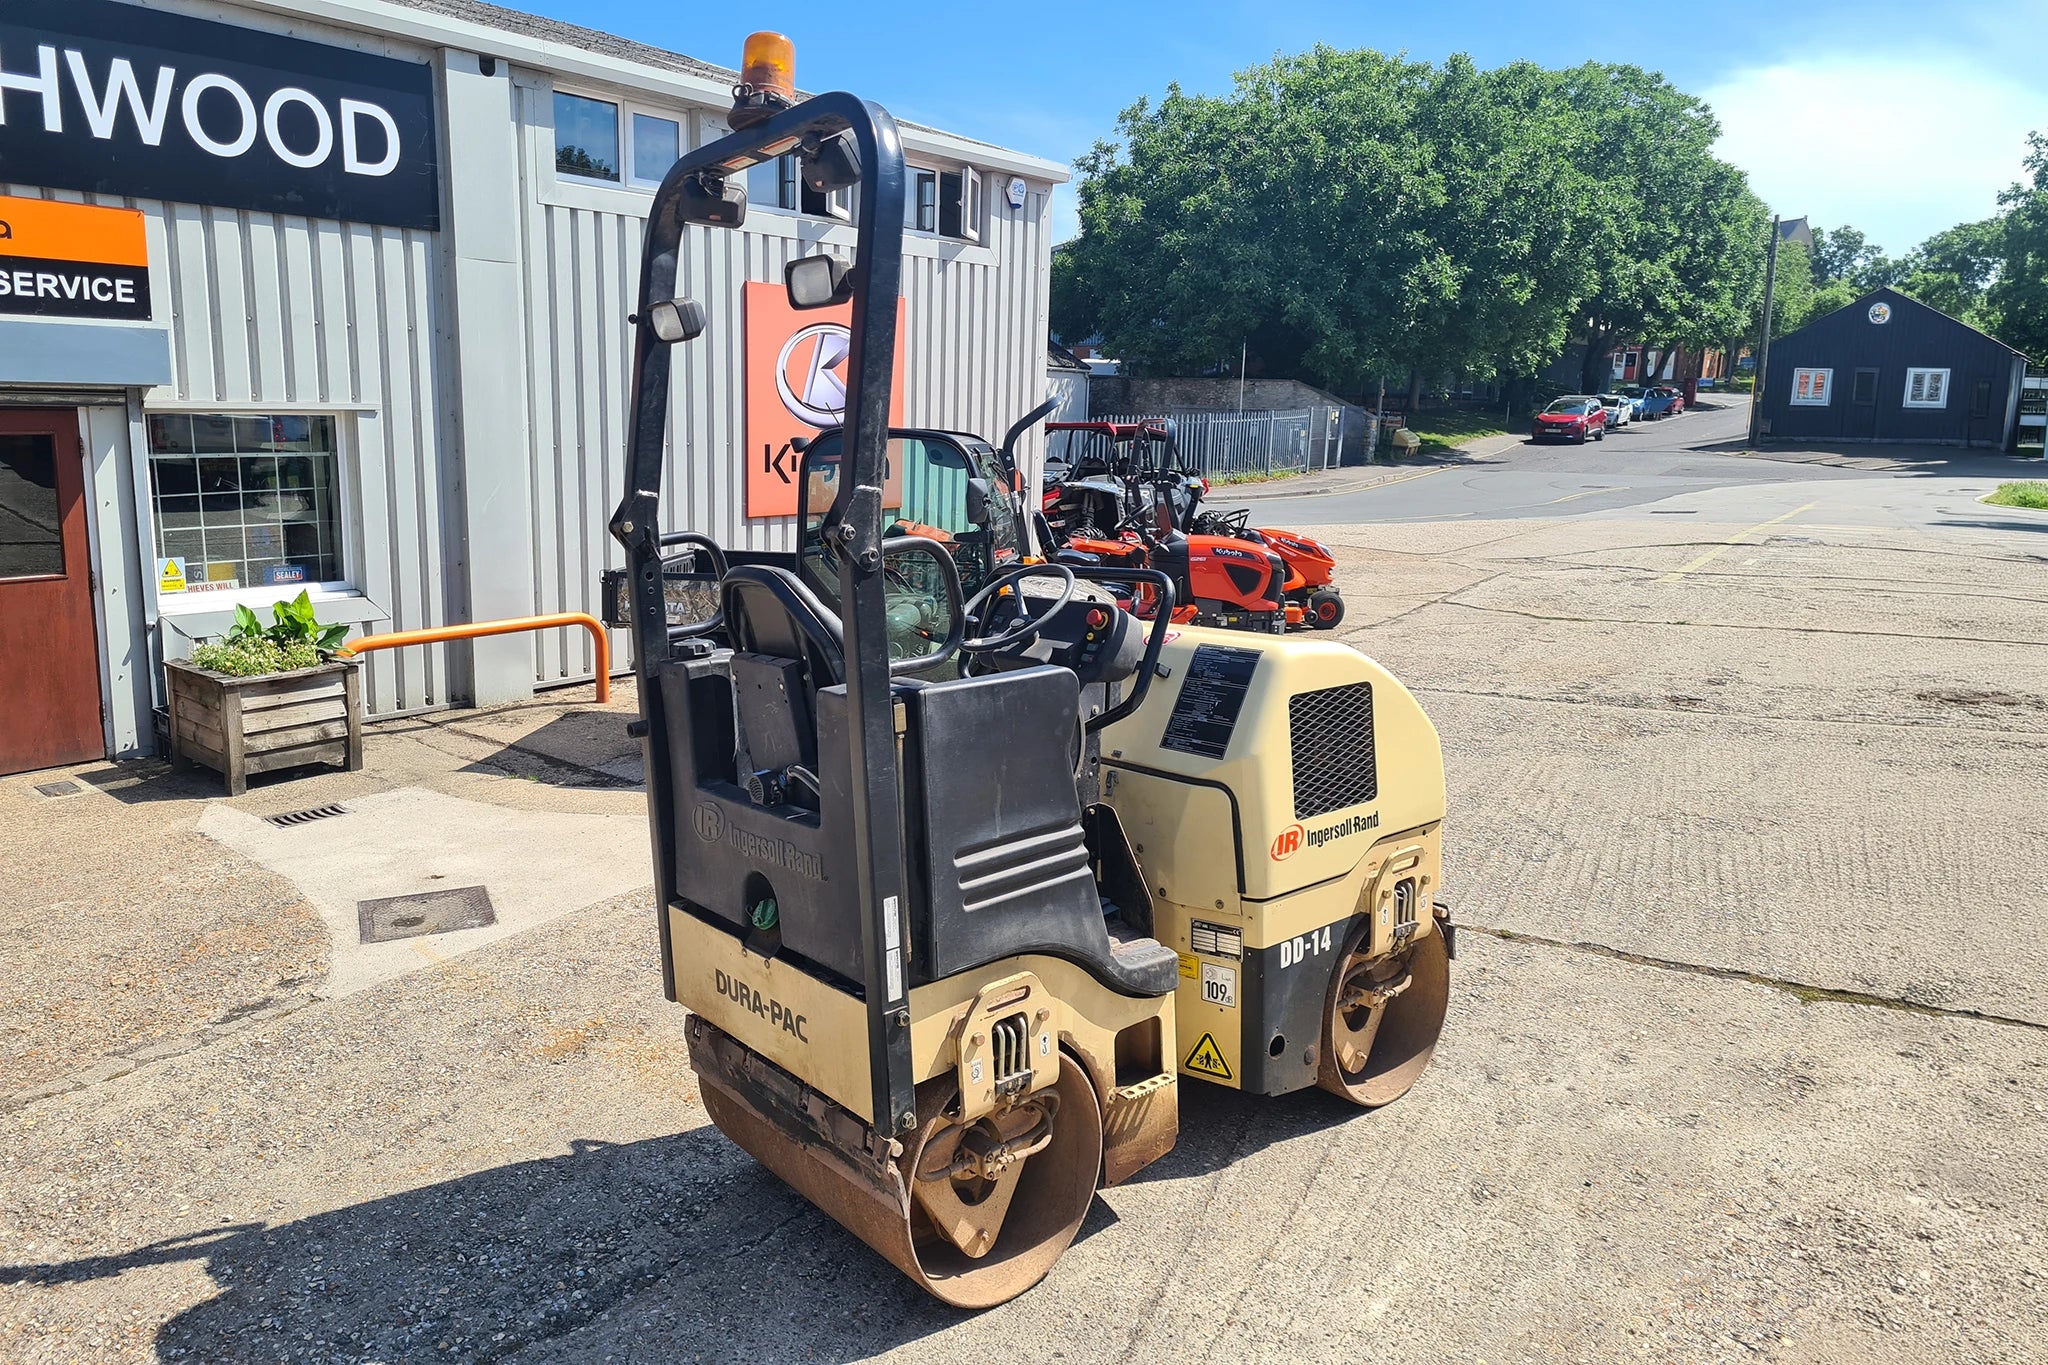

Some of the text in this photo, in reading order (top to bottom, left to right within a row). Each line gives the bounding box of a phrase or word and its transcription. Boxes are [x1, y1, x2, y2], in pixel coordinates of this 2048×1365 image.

[0, 269, 136, 303] SERVICE
[1216, 547, 1243, 557] Kubota
[276, 570, 300, 580] SEALEY
[187, 583, 214, 593] HIEVES
[216, 582, 234, 590] WILL
[1276, 830, 1300, 856] IR
[1280, 926, 1332, 969] DD-14
[1205, 980, 1227, 1002] 109
[715, 968, 809, 1044] DURA-PAC
